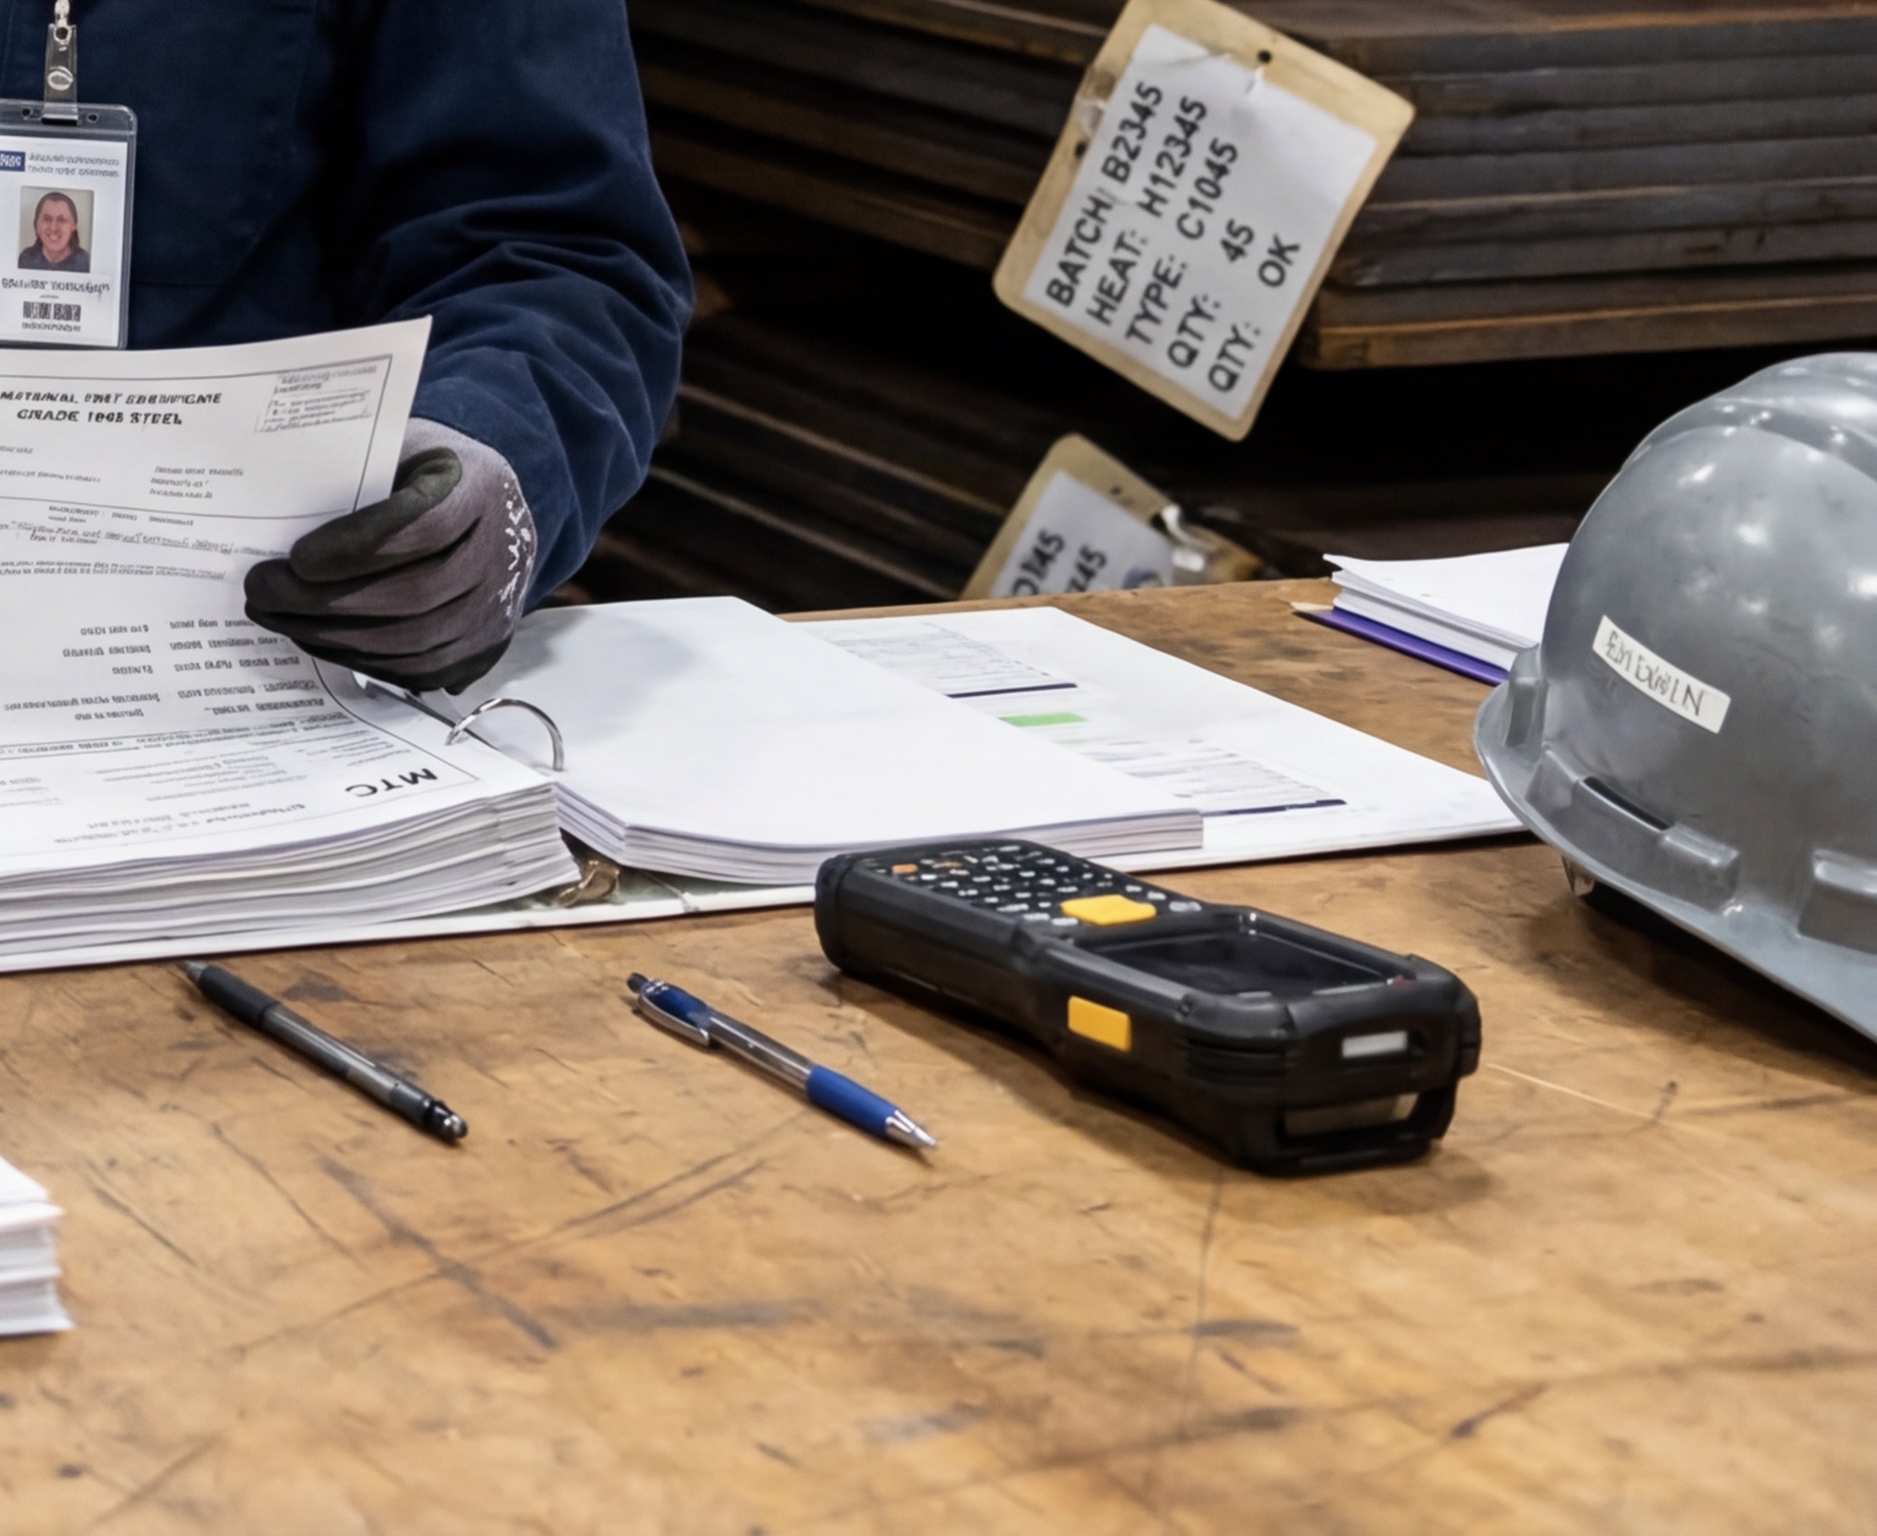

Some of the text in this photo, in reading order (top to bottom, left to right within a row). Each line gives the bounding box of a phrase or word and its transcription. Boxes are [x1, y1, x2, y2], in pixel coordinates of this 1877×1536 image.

[1102, 81, 1163, 185] B2345
[1085, 94, 1207, 327] HEAT: H12345
[1125, 136, 1238, 347] TYPE: C1045
[1166, 218, 1254, 368] QTY: 45
[1206, 234, 1301, 393] QTY: OK
[345, 768, 438, 798] MTC
